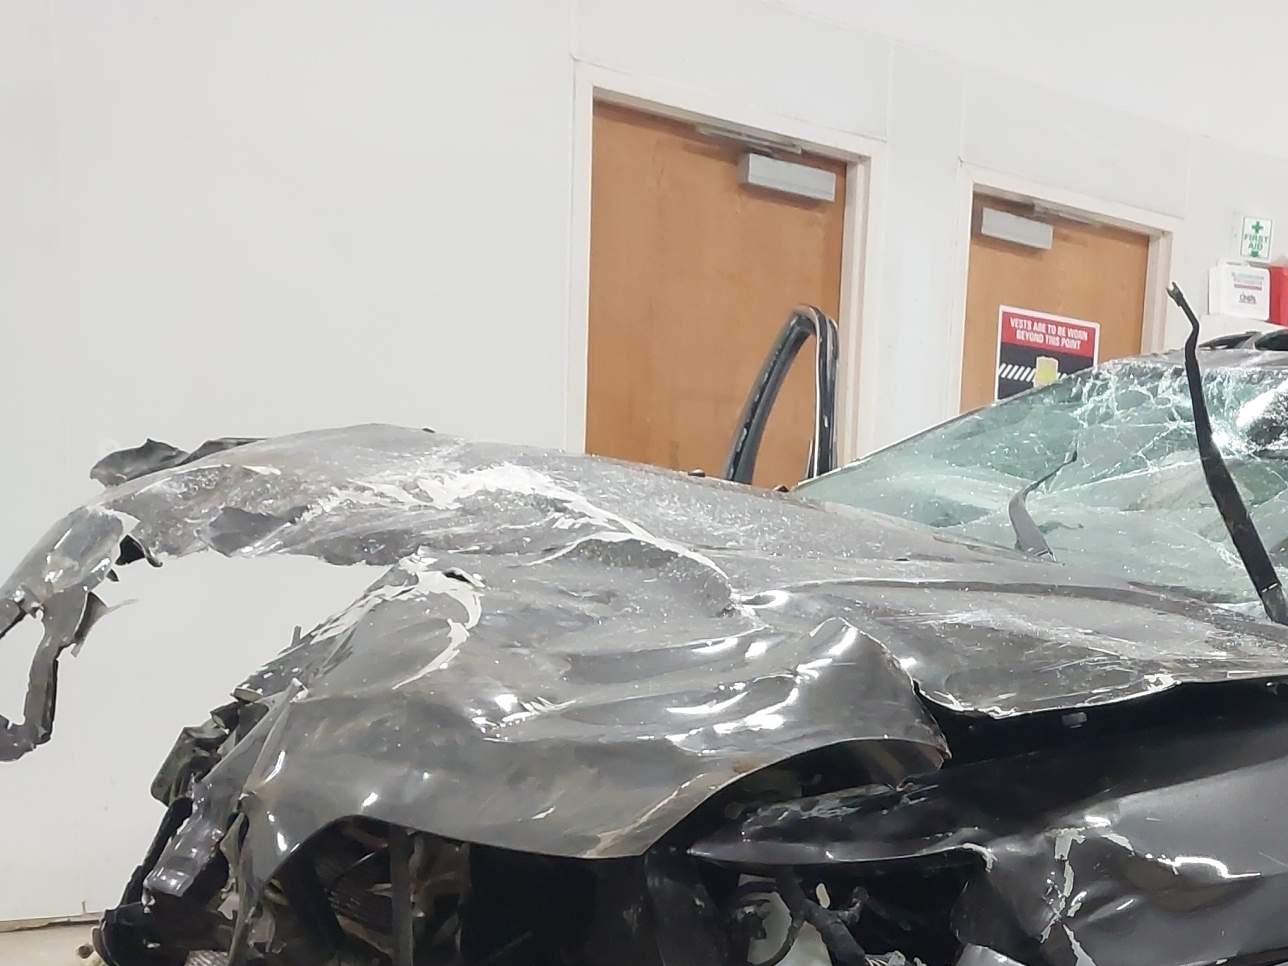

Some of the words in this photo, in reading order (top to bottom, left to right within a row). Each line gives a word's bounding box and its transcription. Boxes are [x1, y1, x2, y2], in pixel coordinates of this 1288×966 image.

[1244, 233, 1268, 243] FIRST
[1248, 241, 1263, 250] AID
[1009, 317, 1032, 328] VESTS
[1033, 321, 1047, 332] ARE
[1048, 324, 1056, 335] TO
[1057, 326, 1066, 336] BE
[1067, 328, 1088, 341] WORN
[1016, 330, 1044, 343] BEYOND
[1045, 335, 1060, 346] THIS
[1061, 338, 1081, 350] POINT
